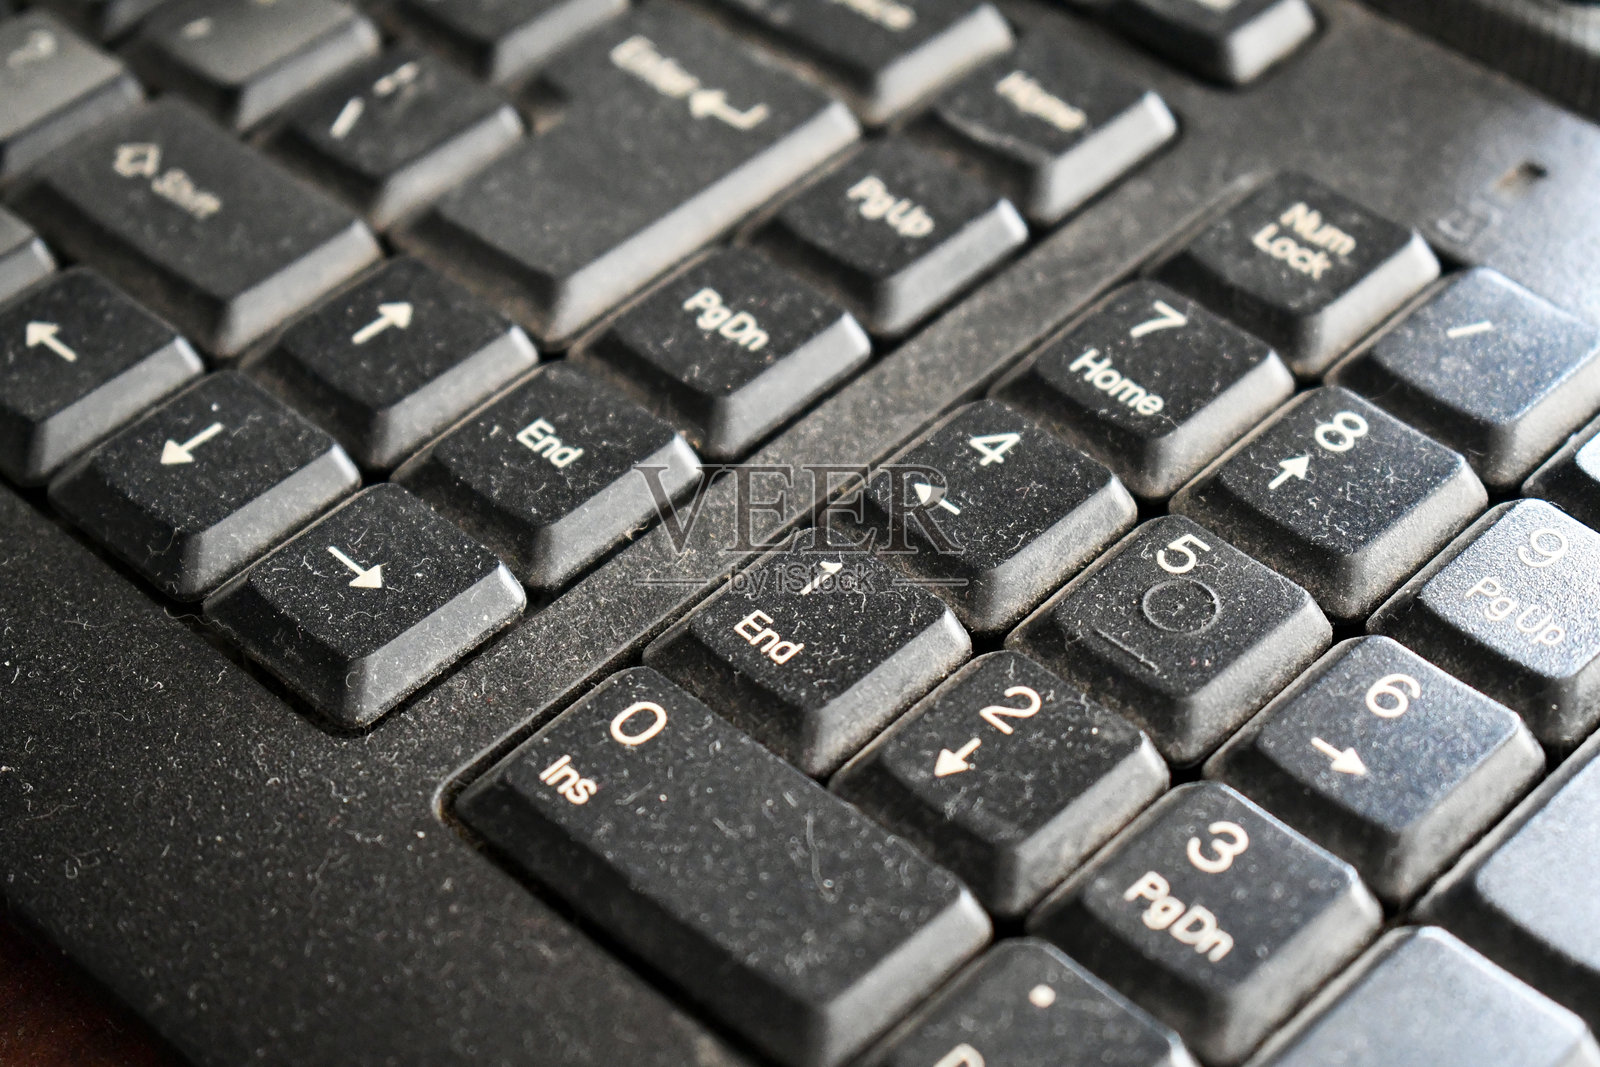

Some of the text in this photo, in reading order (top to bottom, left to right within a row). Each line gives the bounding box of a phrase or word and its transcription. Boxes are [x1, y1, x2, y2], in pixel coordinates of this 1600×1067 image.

[1252, 223, 1332, 281] Lock
[1279, 202, 1357, 256] Num
[683, 287, 770, 351] PgDn
[1129, 299, 1188, 339] 7
[1069, 347, 1165, 416] Home
[515, 418, 584, 469] End
[969, 432, 1021, 467] 4
[1314, 411, 1369, 453] 8
[1156, 533, 1211, 574] 5
[1516, 527, 1570, 569] 9
[733, 608, 803, 666] End
[979, 685, 1042, 735] 2
[1365, 673, 1421, 719] 6
[538, 754, 599, 806] Ins
[1186, 820, 1250, 874] 3
[1123, 870, 1235, 963] PgDn
